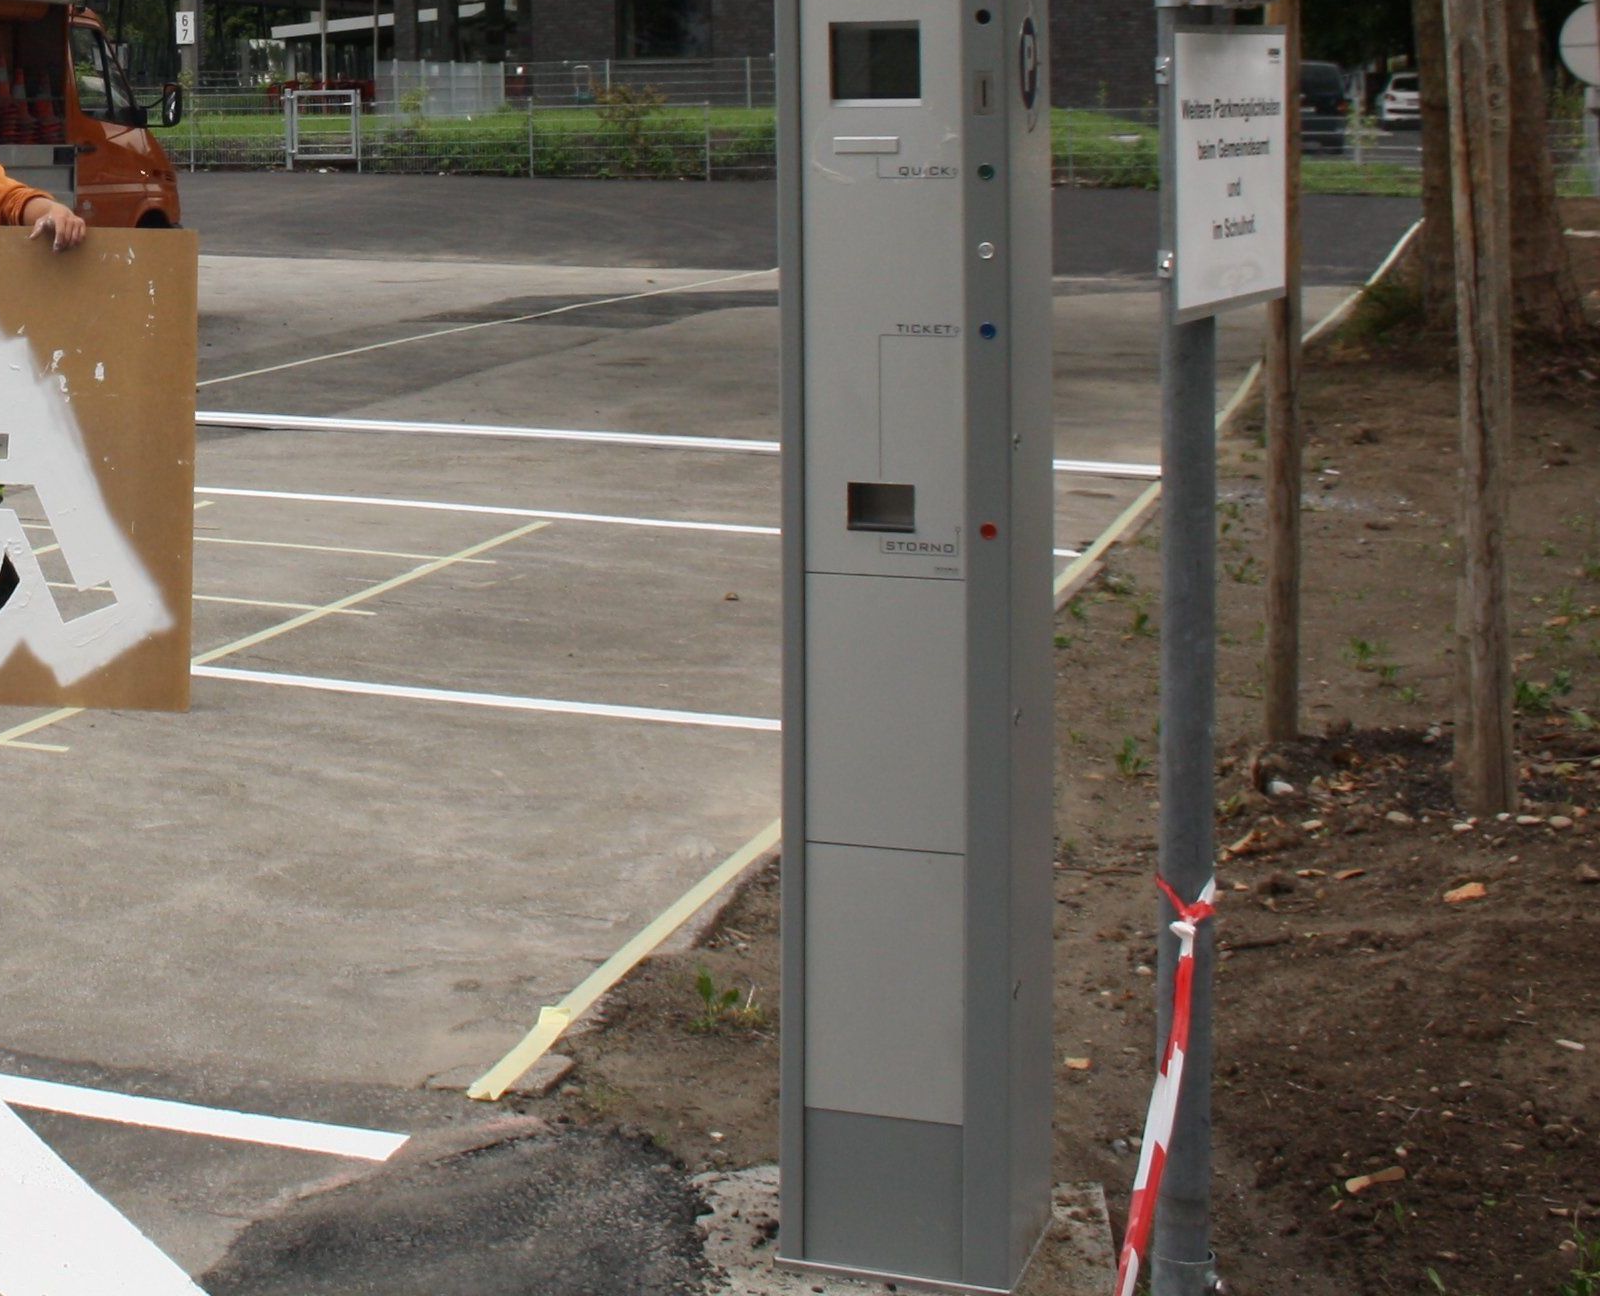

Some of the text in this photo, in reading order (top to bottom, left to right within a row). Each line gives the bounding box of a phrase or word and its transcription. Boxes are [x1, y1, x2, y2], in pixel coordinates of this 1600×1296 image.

[181, 14, 189, 27] 6
[181, 28, 188, 41] 7
[1181, 99, 1212, 120] Weitere
[1197, 136, 1270, 160] beim Gemeindeamt
[1226, 177, 1241, 197] und
[1212, 220, 1223, 240] im
[896, 323, 952, 334] TICKET
[885, 540, 955, 554] STORNO
